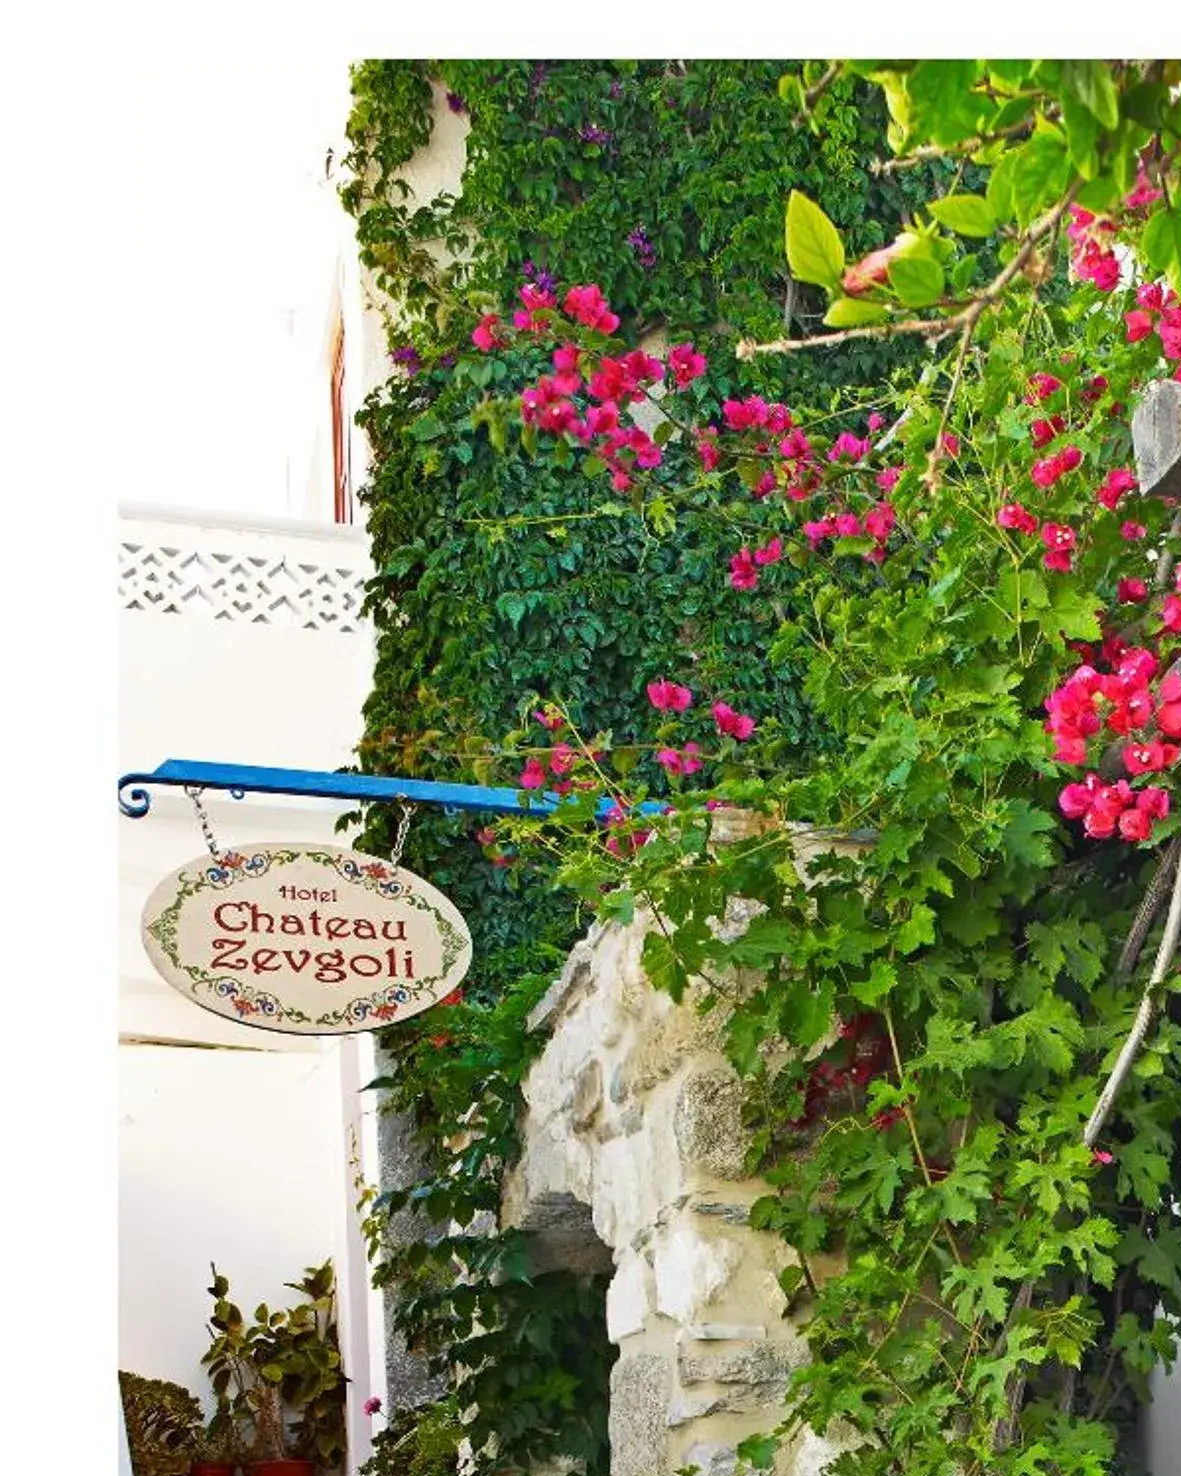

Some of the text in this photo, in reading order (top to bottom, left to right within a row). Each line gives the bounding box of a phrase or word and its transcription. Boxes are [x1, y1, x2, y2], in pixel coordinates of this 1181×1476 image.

[279, 885, 338, 903] Hotel
[213, 901, 408, 941] Chateau
[210, 938, 415, 983] Zevgoli
